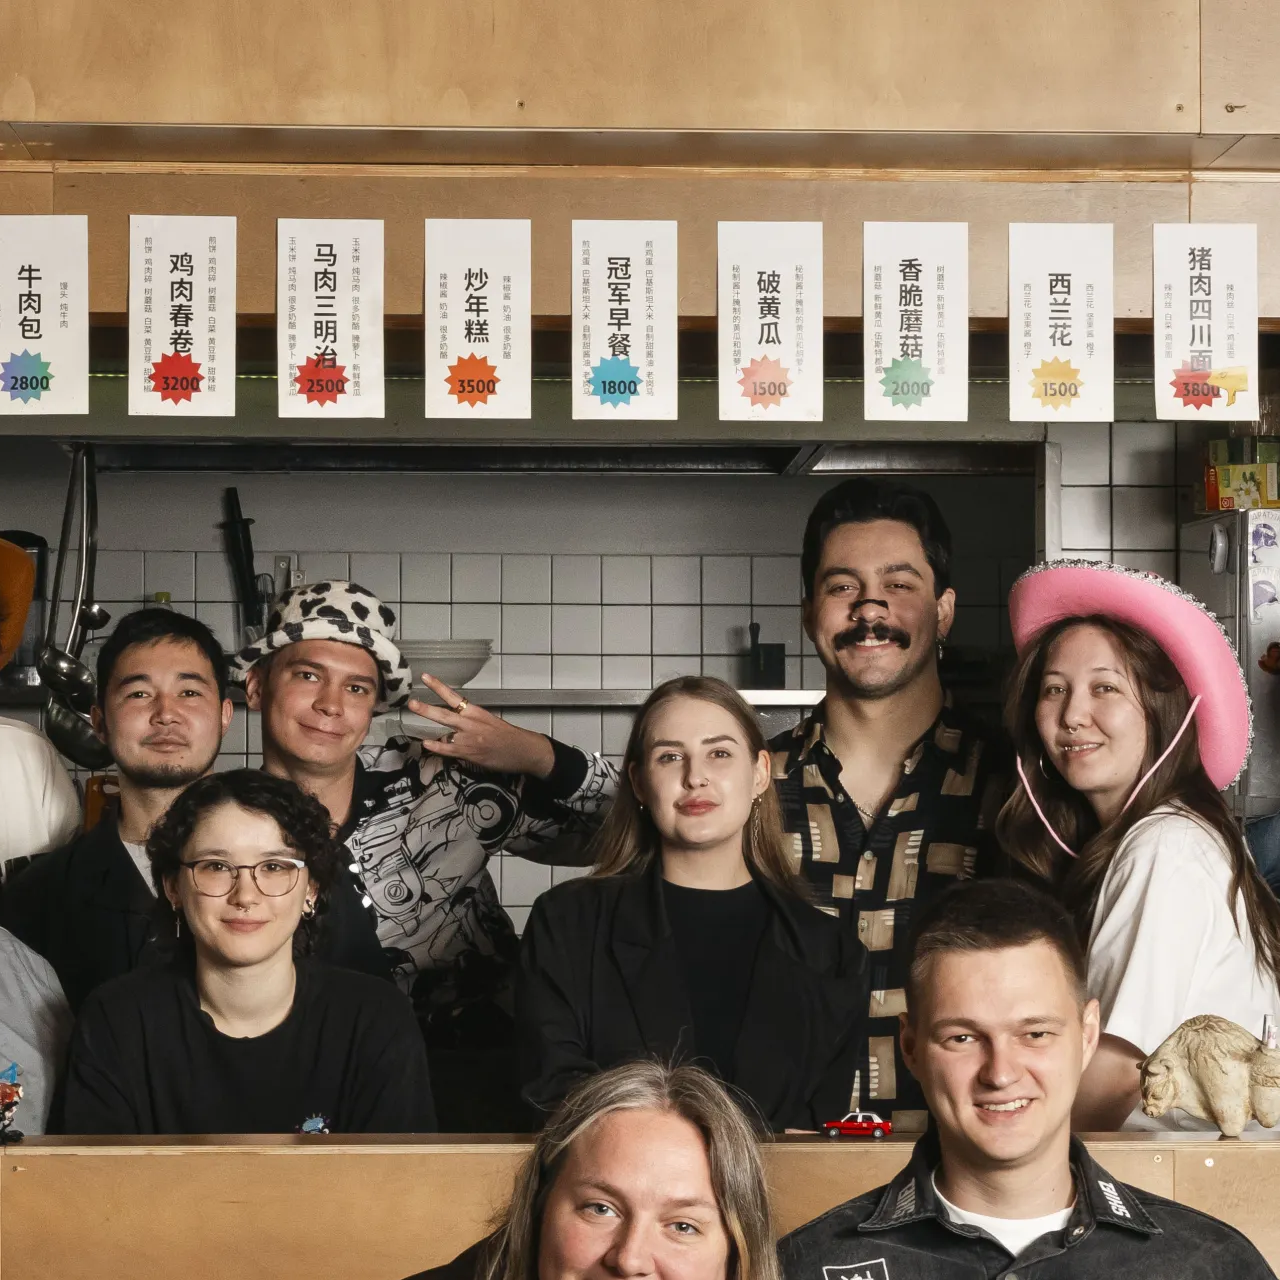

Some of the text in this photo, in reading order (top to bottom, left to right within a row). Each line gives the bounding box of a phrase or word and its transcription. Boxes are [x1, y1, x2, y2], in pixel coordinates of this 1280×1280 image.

[18, 265, 42, 339] 牛肉包
[169, 252, 194, 353] 鸡肉春卷
[314, 244, 337, 369] 马肉三明治
[464, 268, 489, 343] 炒年糕
[607, 257, 631, 357] 冠军早餐
[757, 270, 782, 345] 破黄瓜
[899, 258, 923, 359] 香脆蘑菇
[1048, 273, 1072, 347] 西兰花
[1188, 247, 1213, 372] 猪肉四川面
[10, 376, 49, 390] 2800
[162, 376, 200, 391] 3200
[307, 379, 345, 393] 2500
[458, 379, 496, 393] 3500
[601, 380, 637, 395] 1800
[752, 381, 787, 396] 1500
[892, 381, 930, 396] 2000
[1042, 382, 1078, 397] 1500
[1183, 382, 1220, 397] 3800
